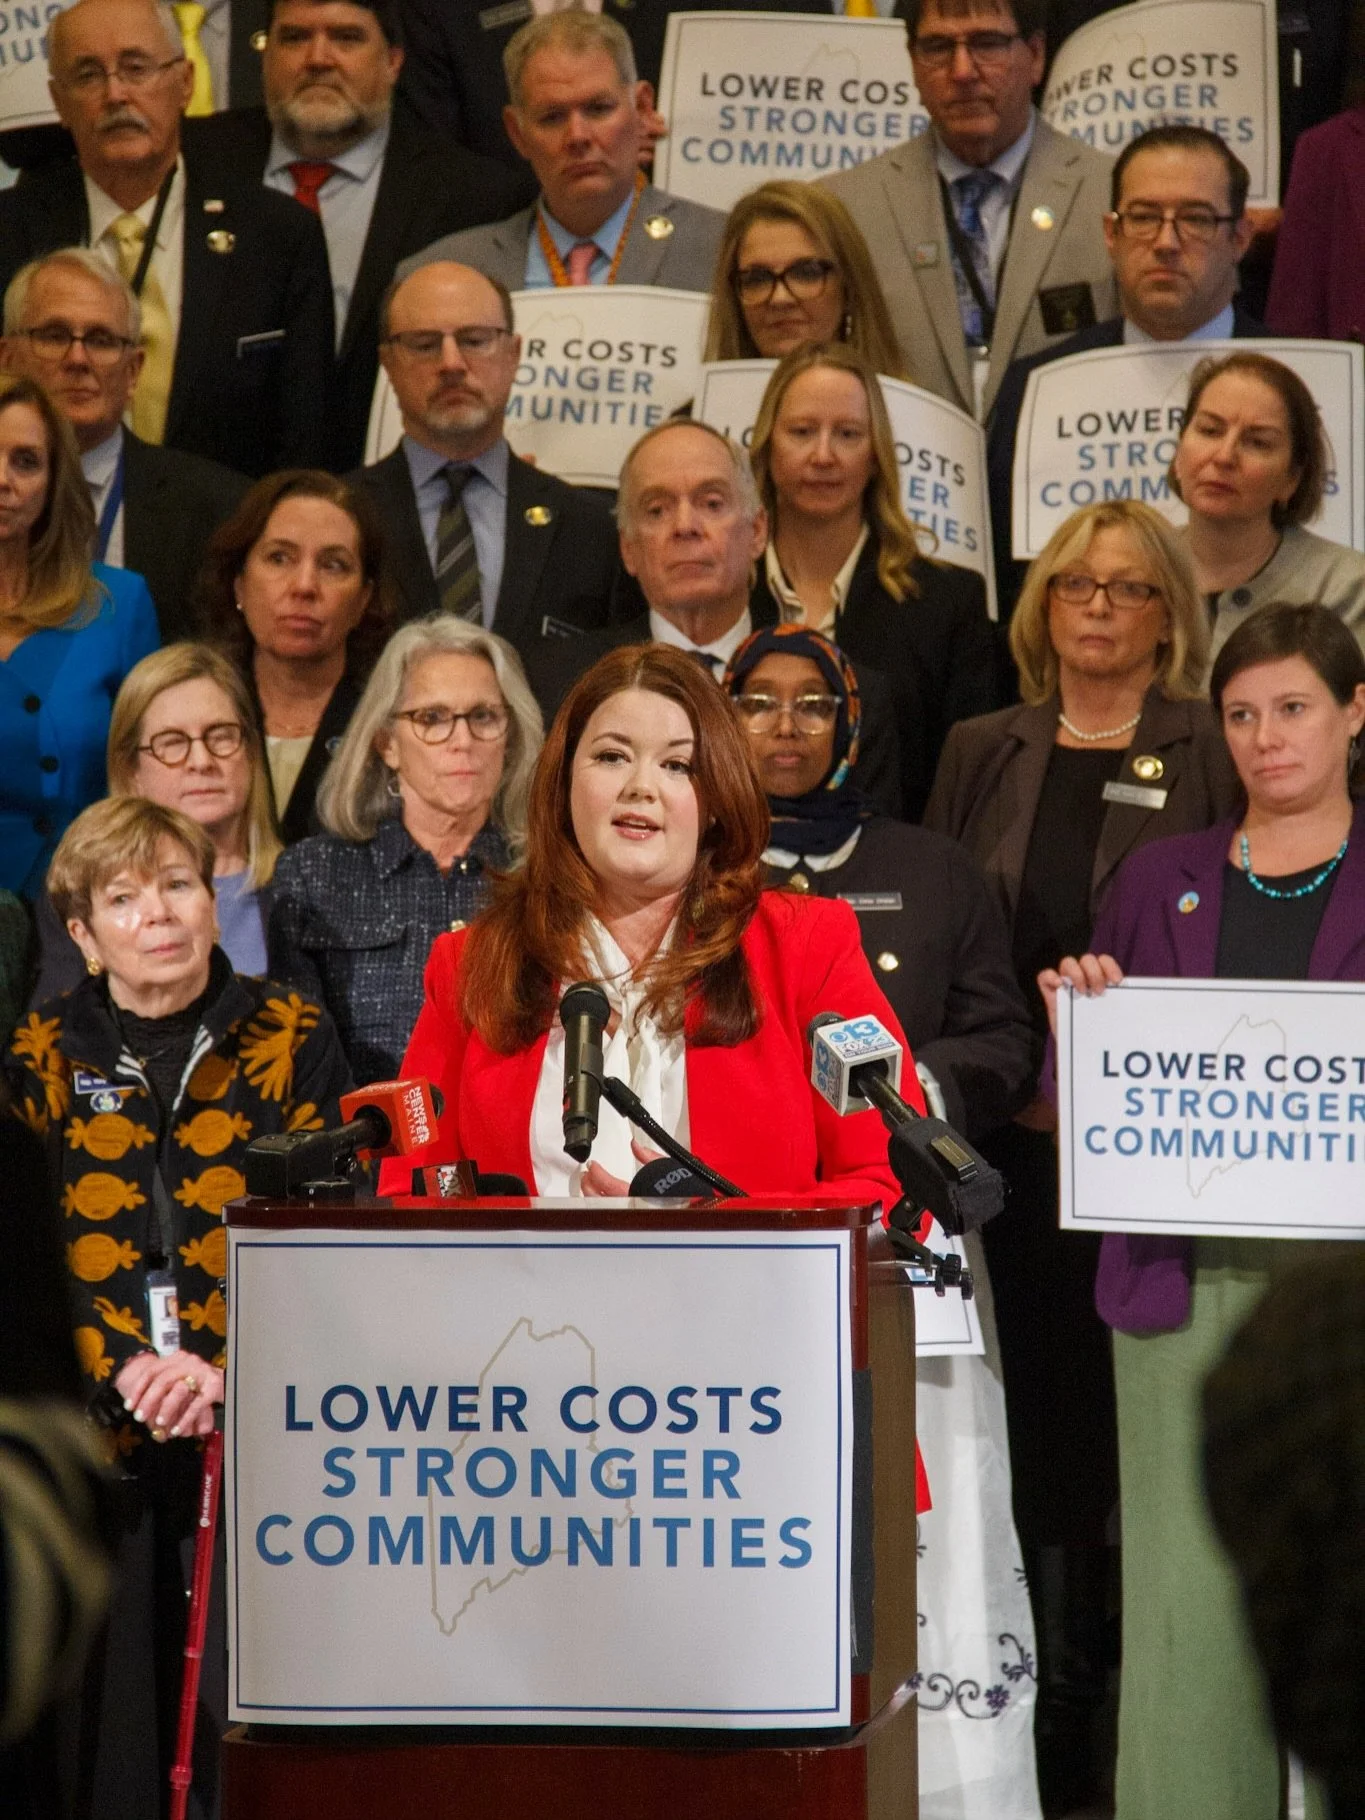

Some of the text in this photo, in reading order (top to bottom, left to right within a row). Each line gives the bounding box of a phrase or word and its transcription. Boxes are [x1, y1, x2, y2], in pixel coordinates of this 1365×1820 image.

[1128, 53, 1239, 80] COSTS
[701, 72, 909, 105] LOWER COS
[1052, 84, 1218, 121] RONGER
[719, 105, 929, 138] STRONGER
[682, 136, 872, 169] COMMUN
[563, 339, 677, 368] COSTS
[514, 364, 653, 395] ONGER
[505, 395, 664, 427] MUNITIE
[1057, 407, 1184, 439] LOWER
[895, 442, 966, 487] OSTS
[1078, 439, 1176, 471] STRO
[843, 1021, 881, 1040] 13
[1103, 1051, 1365, 1084] LOWER COST
[403, 1095, 418, 1144] MAINE
[409, 1089, 425, 1143] CENTER
[414, 1086, 428, 1128] NEWS
[1125, 1087, 1365, 1122] STRONGER
[1085, 1125, 1355, 1162] COMMUNITI
[654, 1168, 693, 1194] RØD
[285, 1385, 783, 1434] LOWER COSTS
[322, 1447, 742, 1499] STRONGER
[255, 1514, 813, 1569] COMMUNITIES
